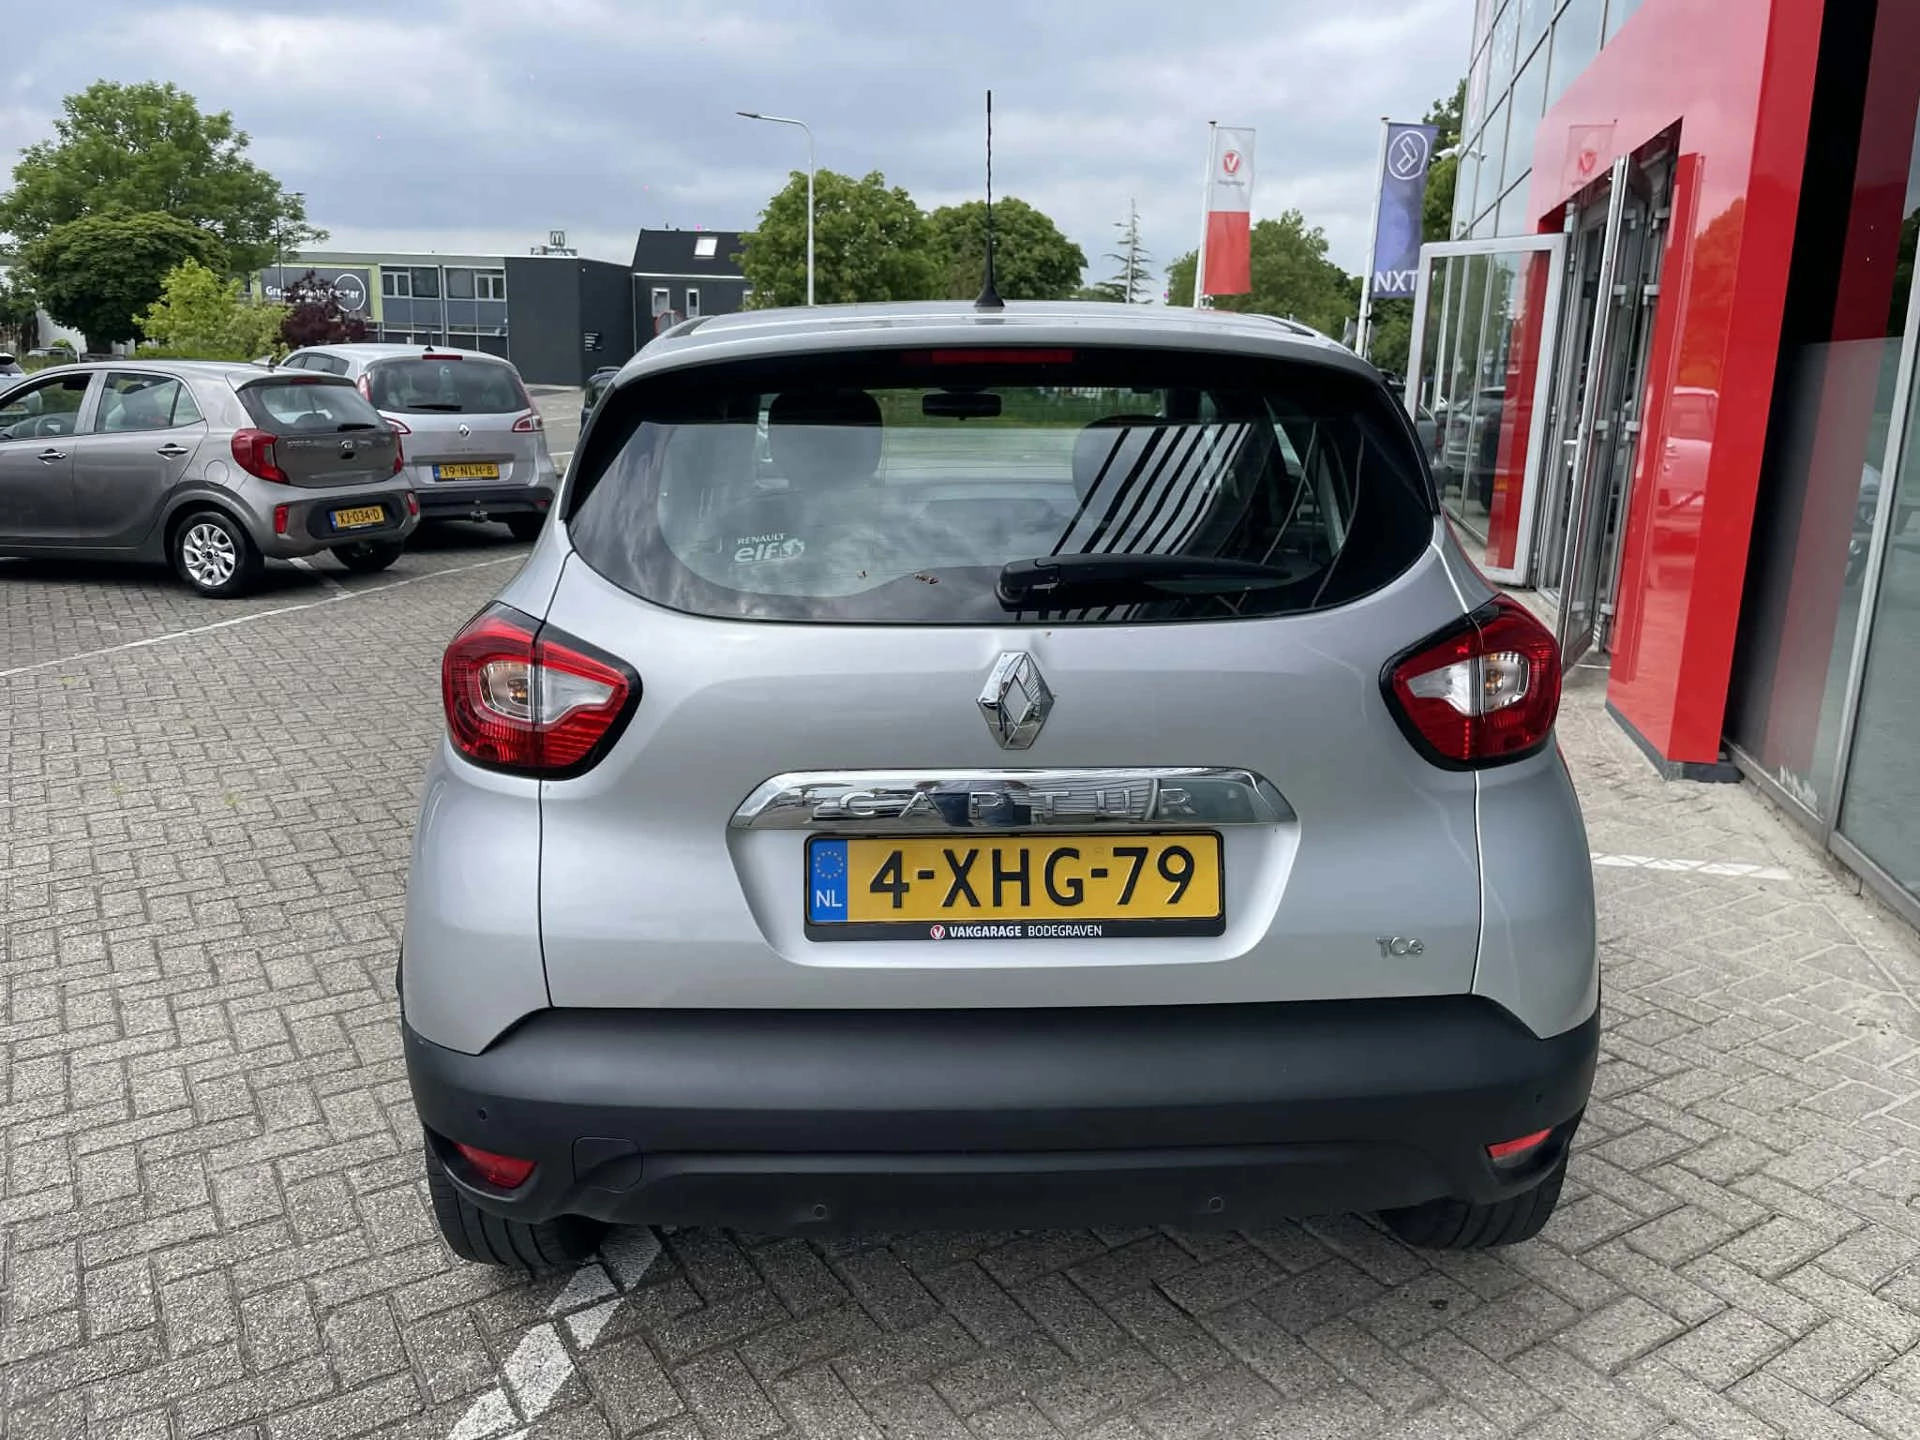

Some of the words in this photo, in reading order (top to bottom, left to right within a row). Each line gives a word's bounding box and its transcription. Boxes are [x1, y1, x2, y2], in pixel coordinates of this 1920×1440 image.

[1374, 270, 1419, 292] NXT
[737, 533, 785, 544] RENAULT
[735, 542, 779, 562] elf
[839, 788, 1196, 818] CAPTUR
[815, 889, 844, 908] NL
[868, 845, 1196, 909] 4-XHG-79
[949, 925, 1022, 938] VAKGARAGE
[1027, 924, 1102, 937] BODEGRAVEN
